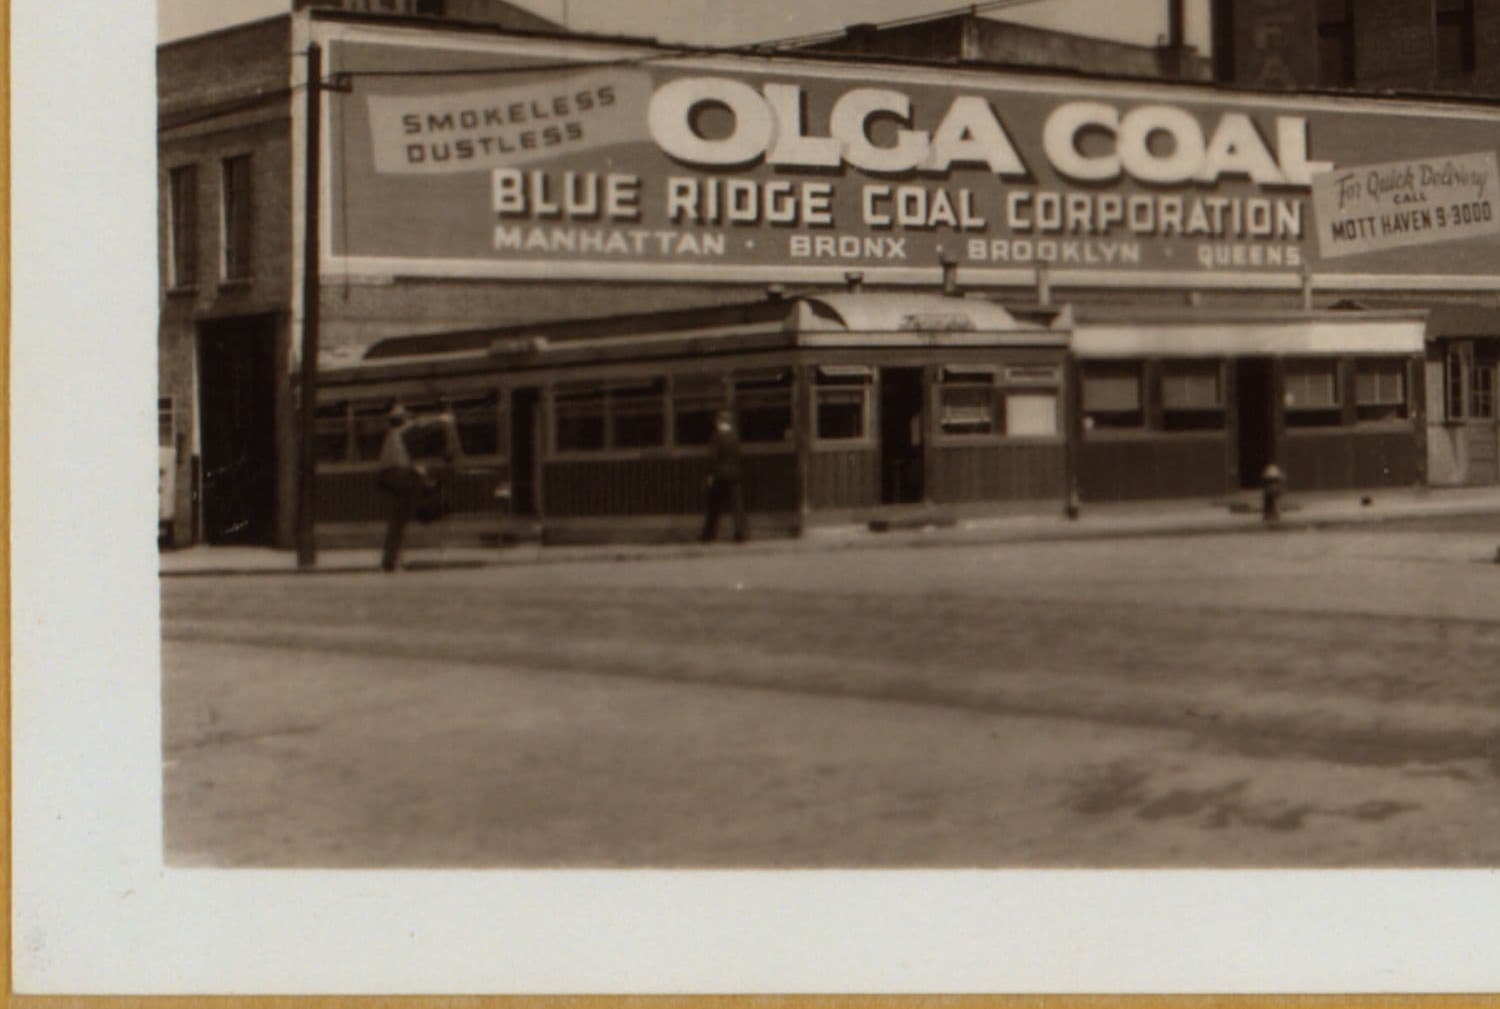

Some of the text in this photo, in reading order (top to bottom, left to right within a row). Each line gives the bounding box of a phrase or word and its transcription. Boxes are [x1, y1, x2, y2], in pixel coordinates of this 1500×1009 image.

[402, 85, 617, 135] SMOKELESS
[647, 76, 1334, 188] OLGA COAL
[405, 121, 584, 164] DUSTLESS
[492, 167, 1302, 237] BLUE RIDGE COAL CORPORATION
[1335, 161, 1490, 210] For Quick Delivery
[1392, 192, 1428, 206] CALL
[492, 225, 1301, 268] MANHATTAN BRONX BROOKLYN QUEENS
[1331, 216, 1376, 241] MOTT
[1380, 206, 1433, 237] HAVEN
